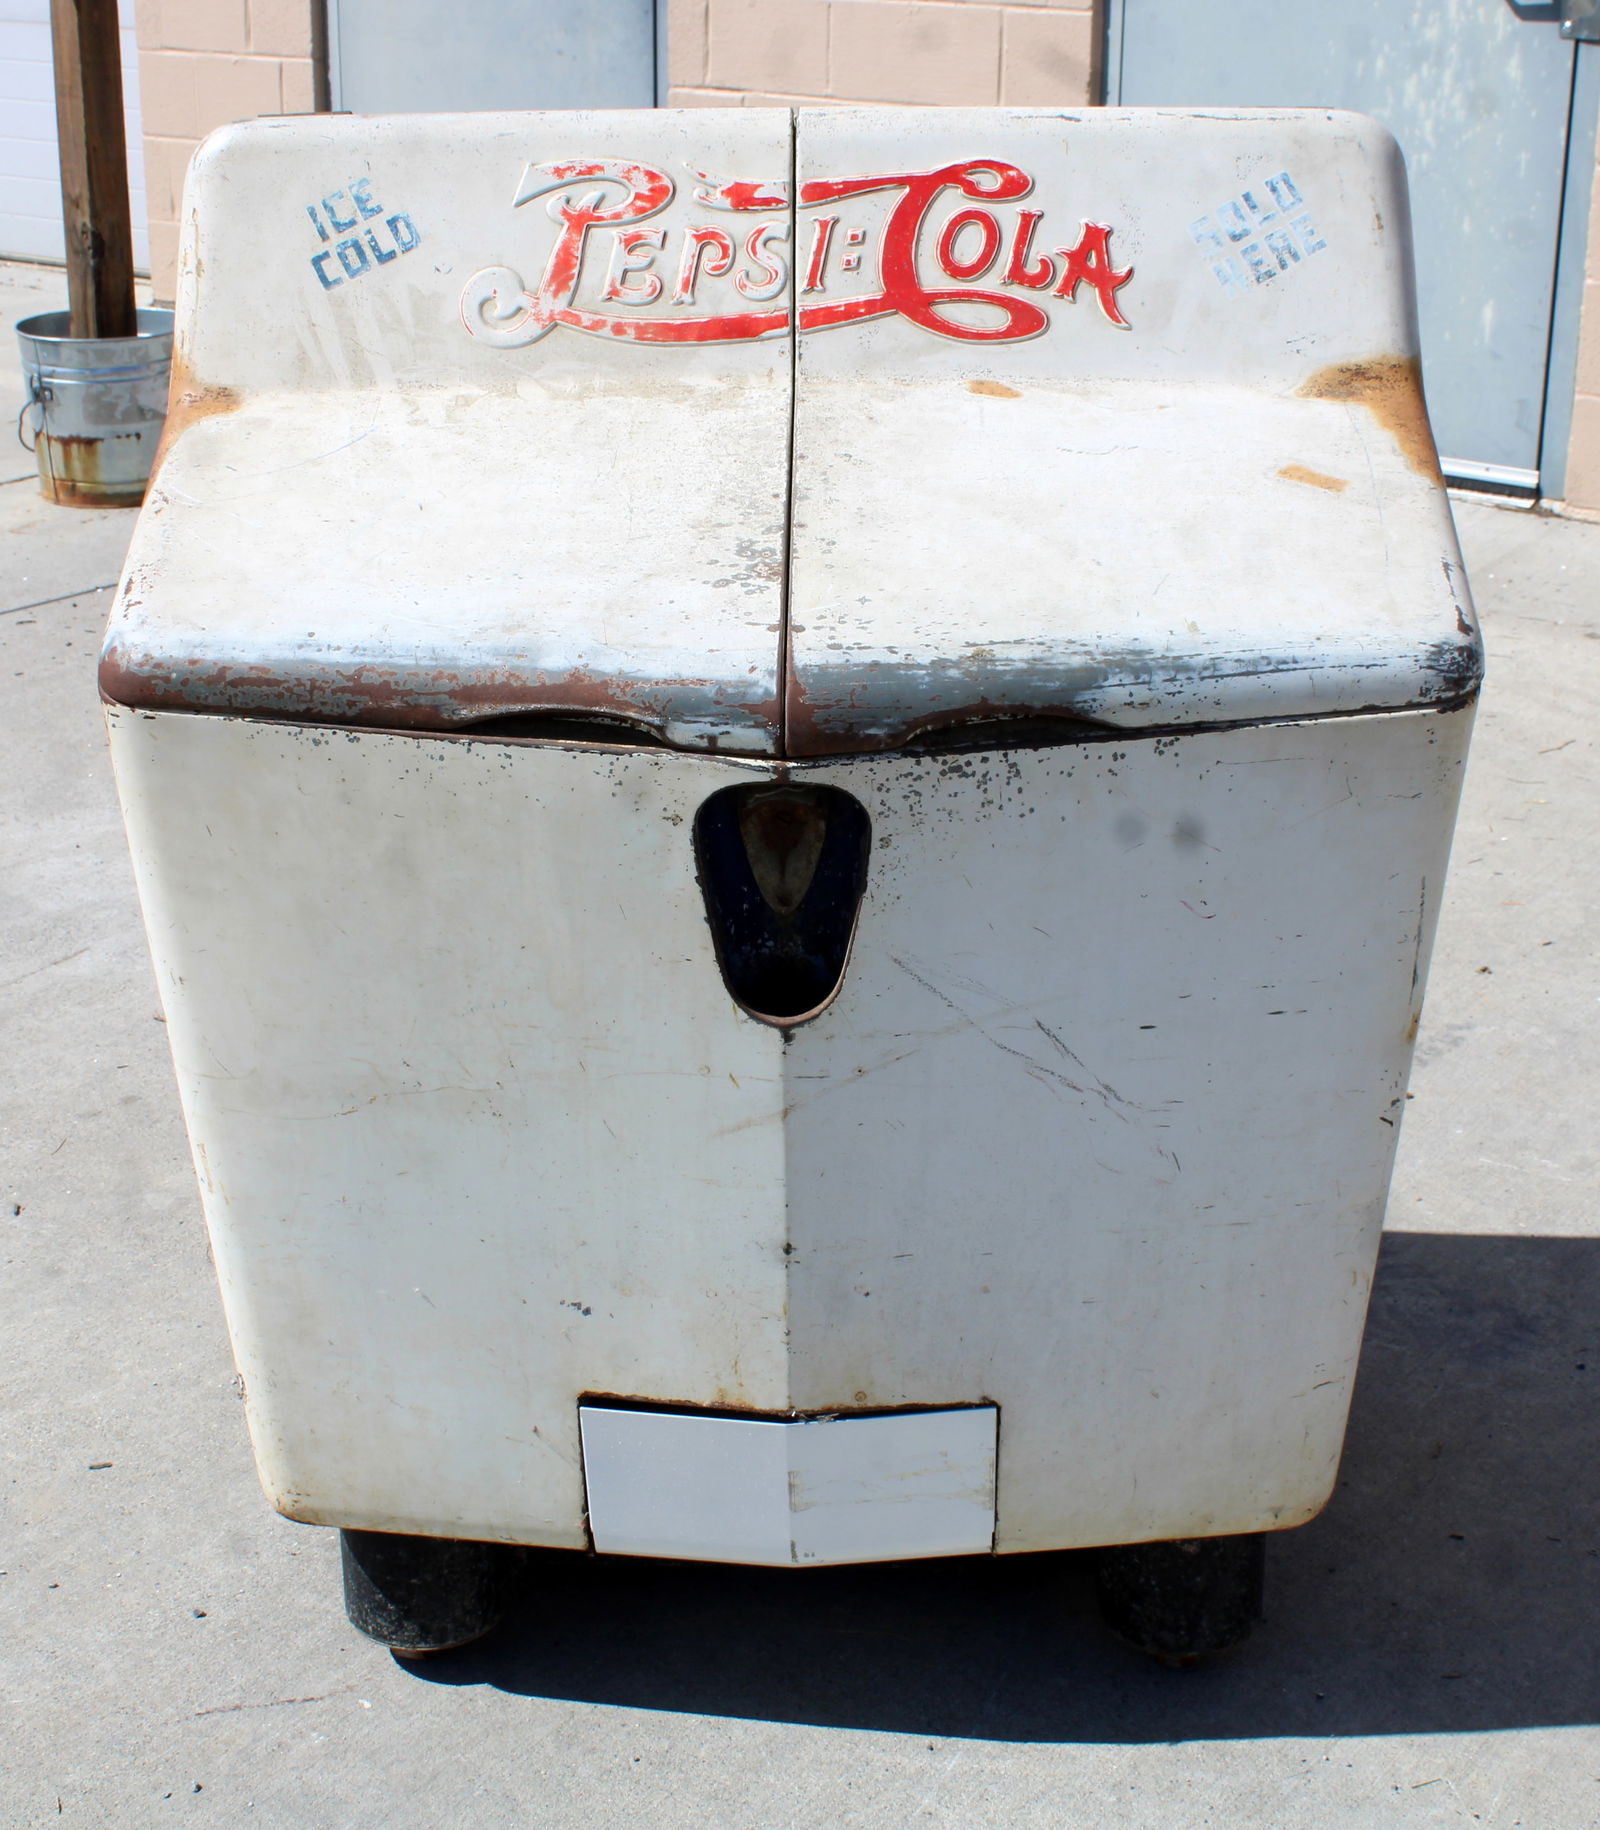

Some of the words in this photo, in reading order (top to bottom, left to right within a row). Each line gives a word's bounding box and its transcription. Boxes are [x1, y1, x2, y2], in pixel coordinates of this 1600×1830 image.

[306, 177, 383, 242] ICE
[1186, 172, 1303, 260] SOLD
[310, 212, 421, 291] COLD
[1211, 213, 1327, 297] HERE
